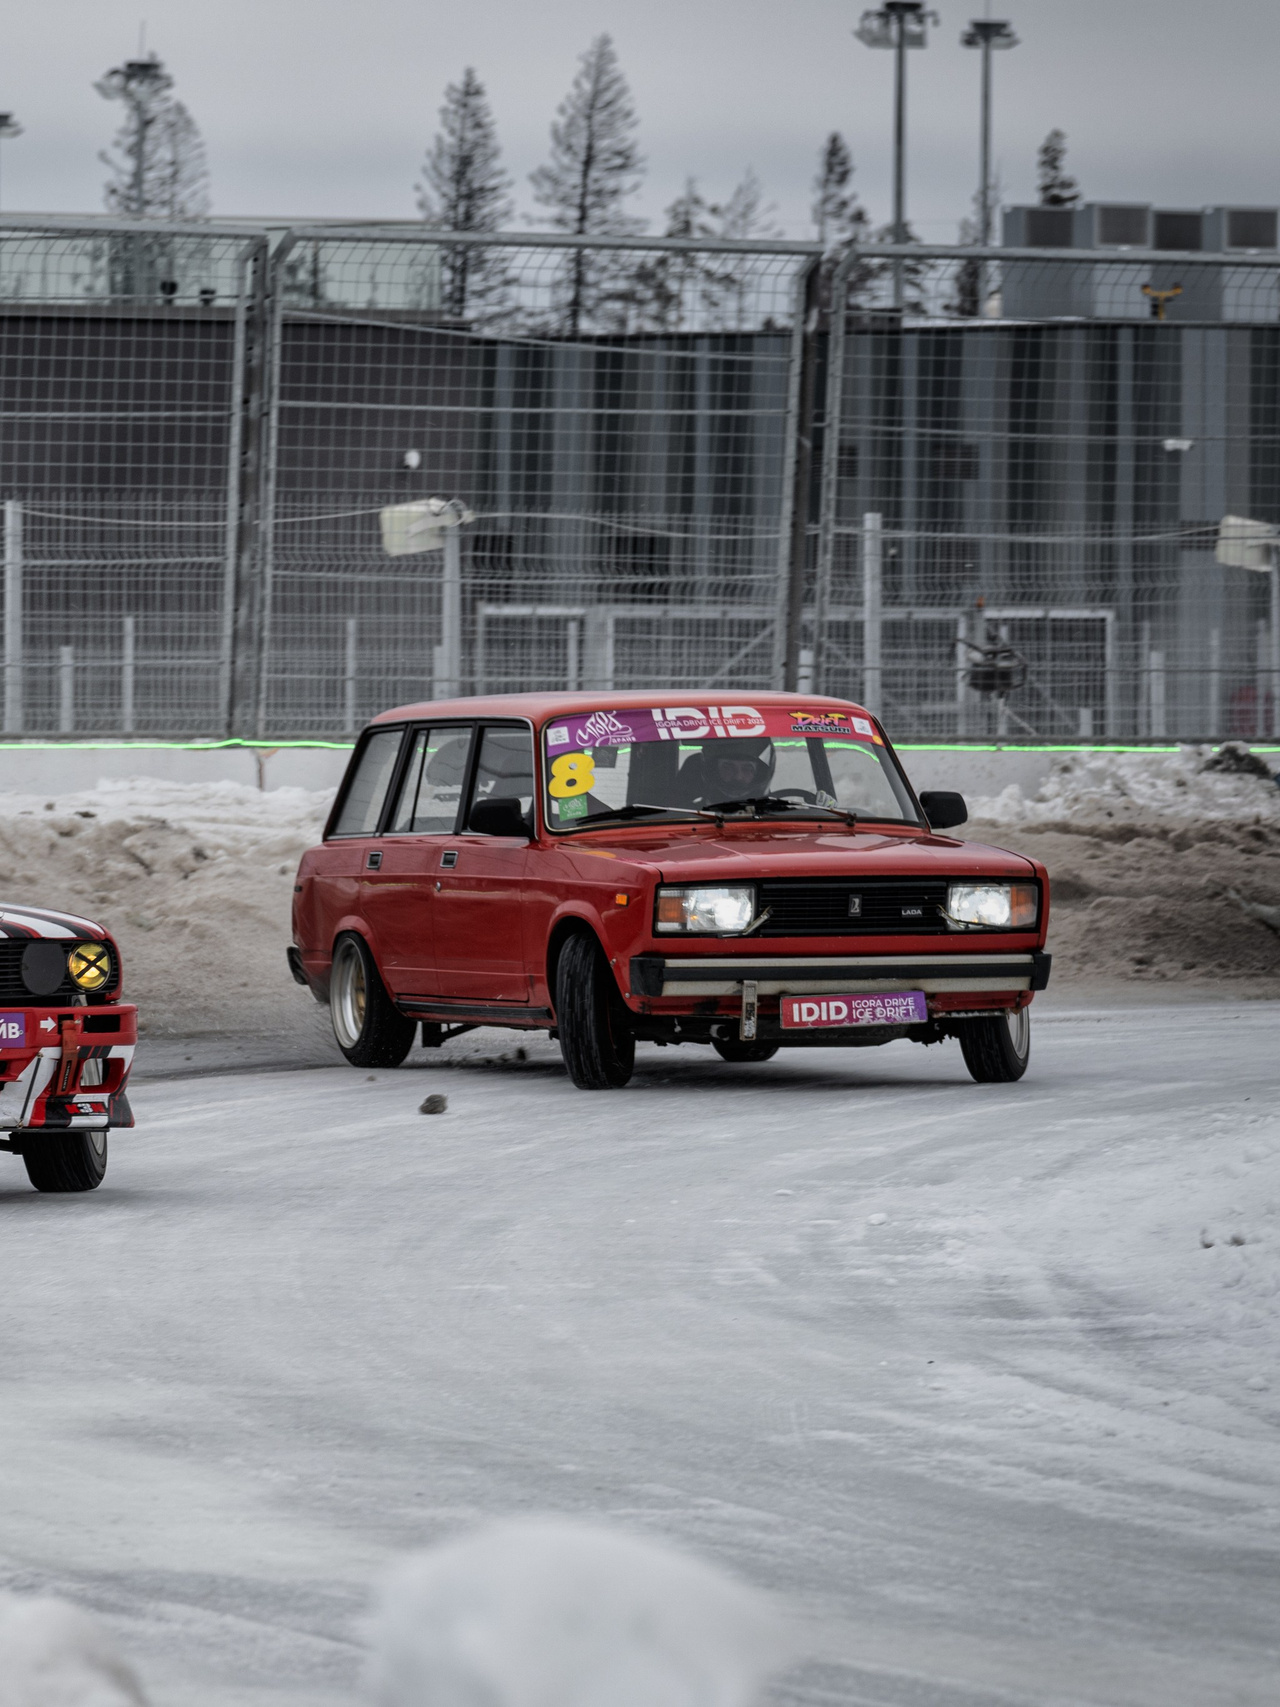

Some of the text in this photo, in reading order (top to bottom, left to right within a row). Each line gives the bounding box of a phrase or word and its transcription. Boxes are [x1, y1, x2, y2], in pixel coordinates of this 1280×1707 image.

[651, 706, 766, 740] IDID
[655, 720, 682, 728] IGORA
[684, 719, 708, 727] DRIVE
[709, 718, 721, 726] ICE
[723, 717, 745, 725] DRIFT
[791, 724, 851, 734] MATSURI
[548, 753, 595, 798] 8
[852, 997, 915, 1009] IGORA DRIVE
[792, 1001, 848, 1023] IDID
[852, 1006, 915, 1019] ICE DRIFT
